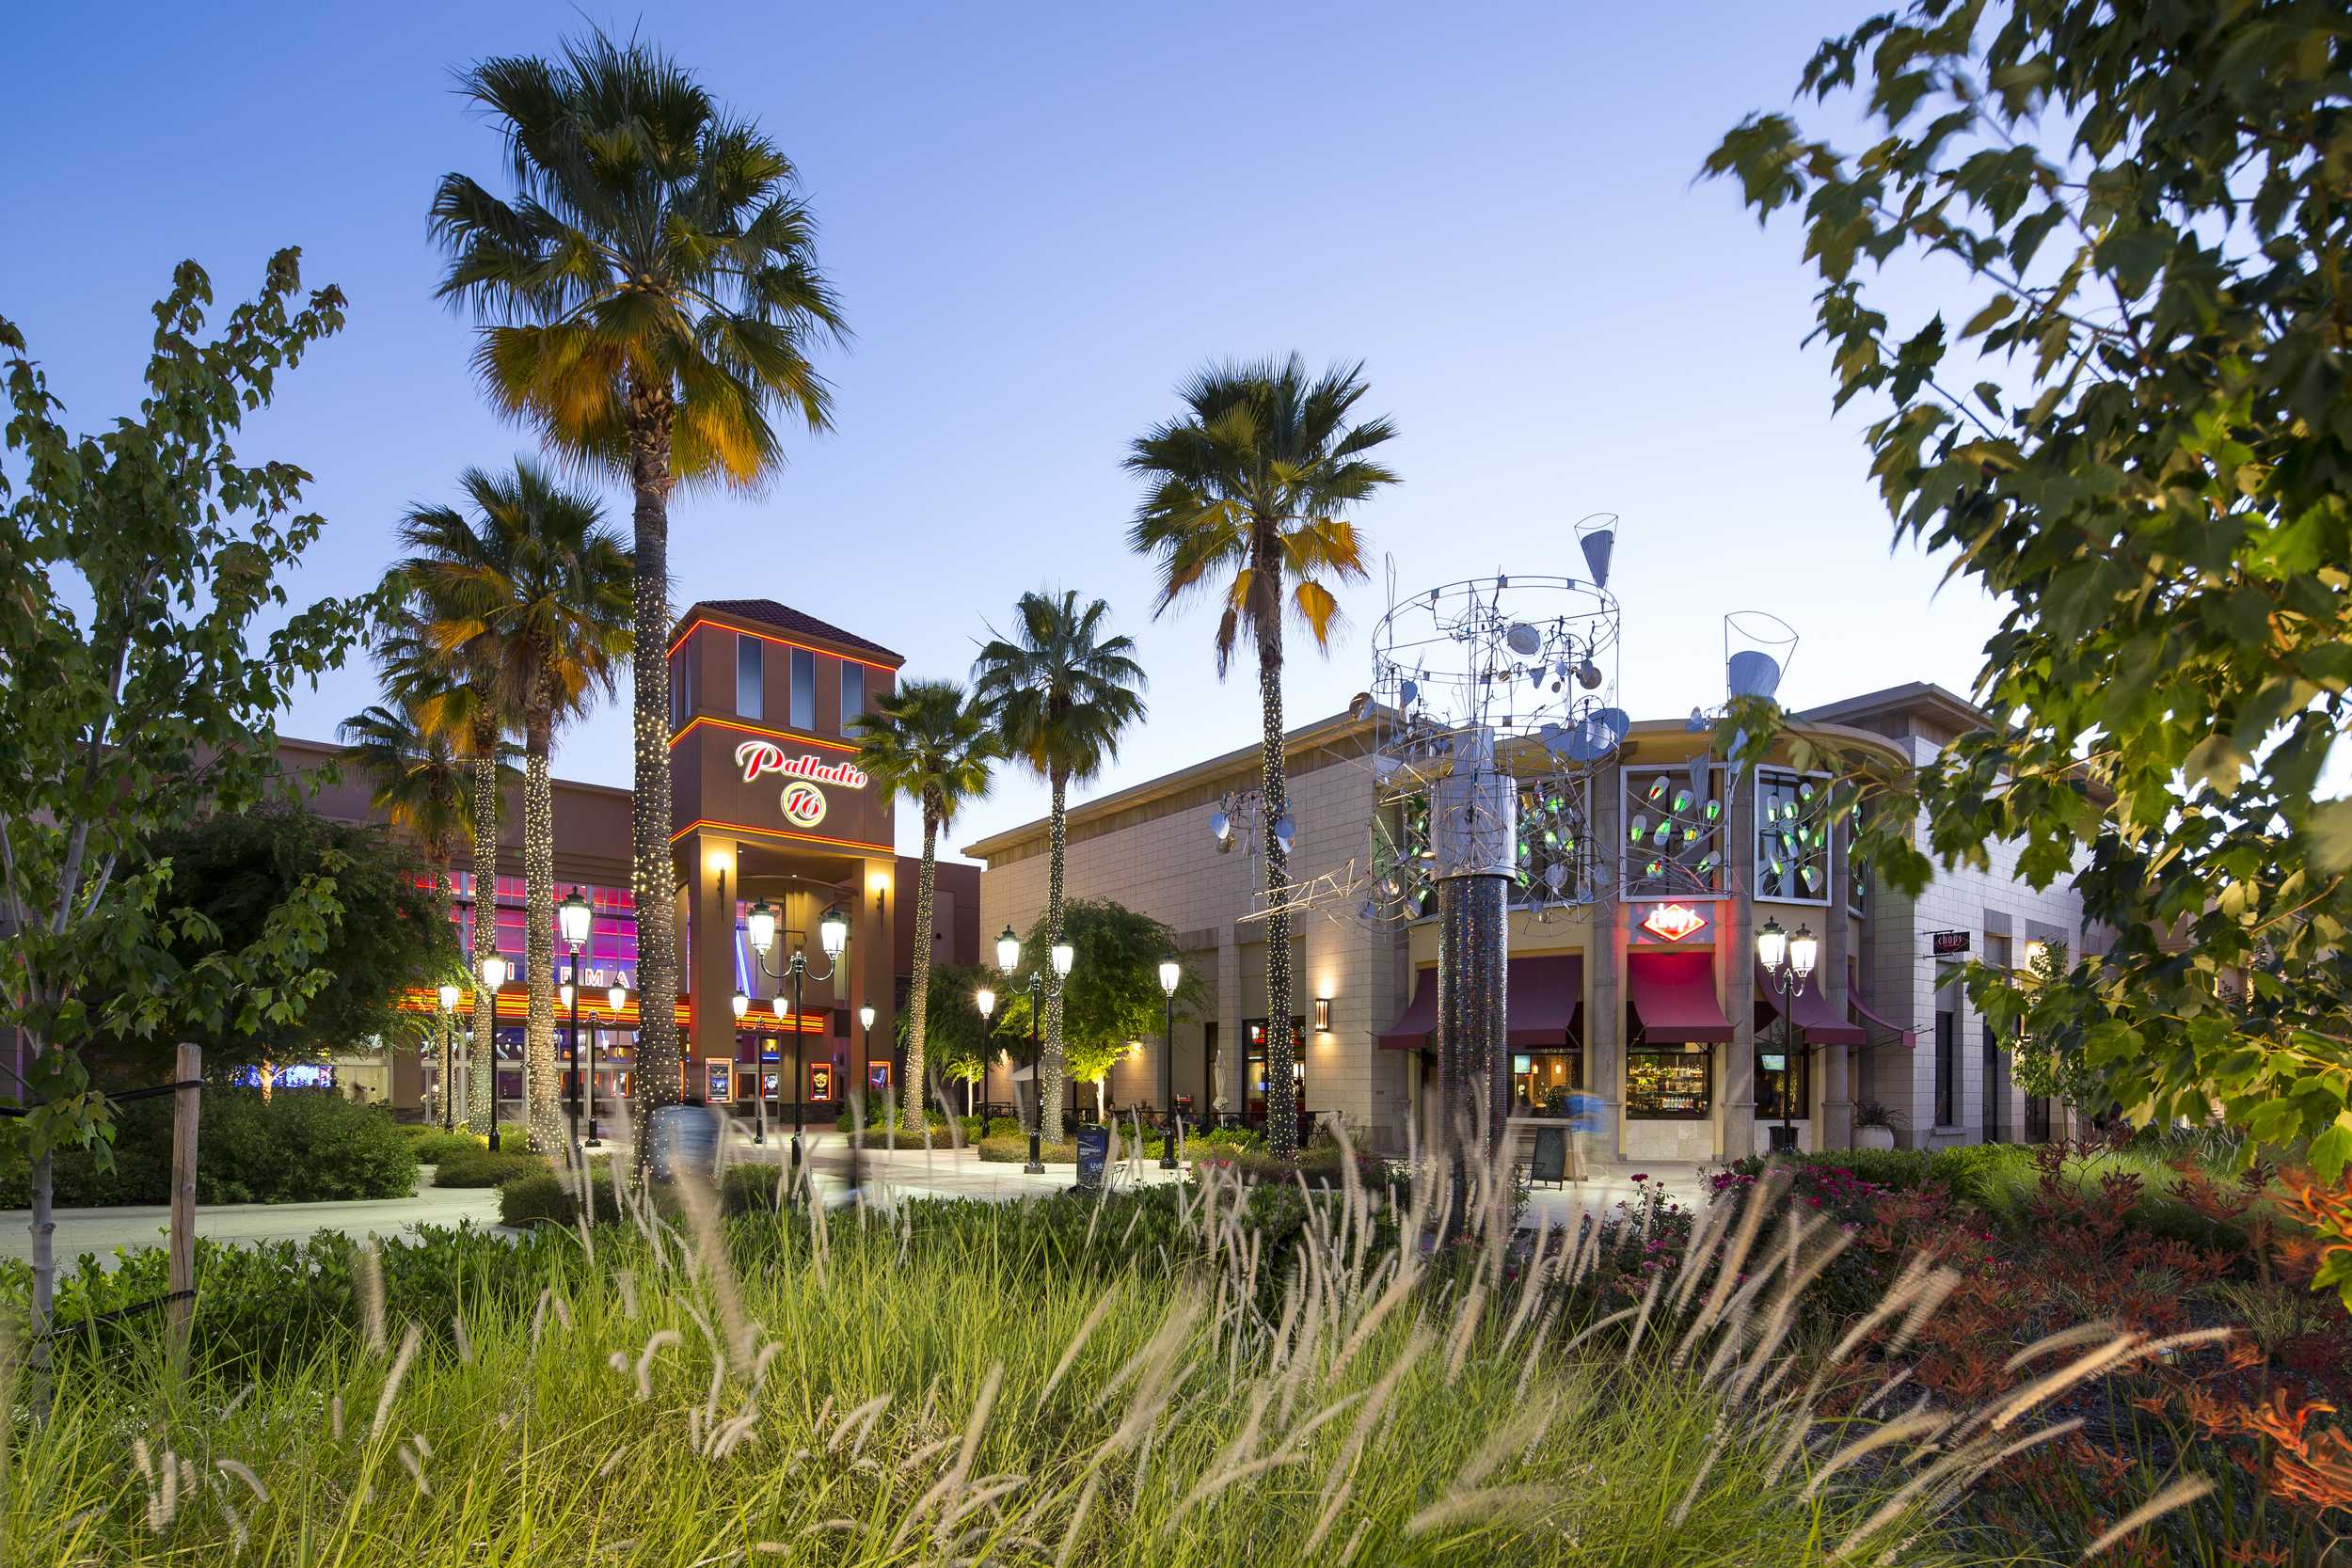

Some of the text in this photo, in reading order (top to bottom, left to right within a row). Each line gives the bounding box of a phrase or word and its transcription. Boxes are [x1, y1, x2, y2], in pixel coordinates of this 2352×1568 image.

[736, 740, 868, 789] Palladio
[788, 789, 822, 819] 16
[1938, 934, 1963, 946] chops
[507, 961, 630, 989] IEMA
